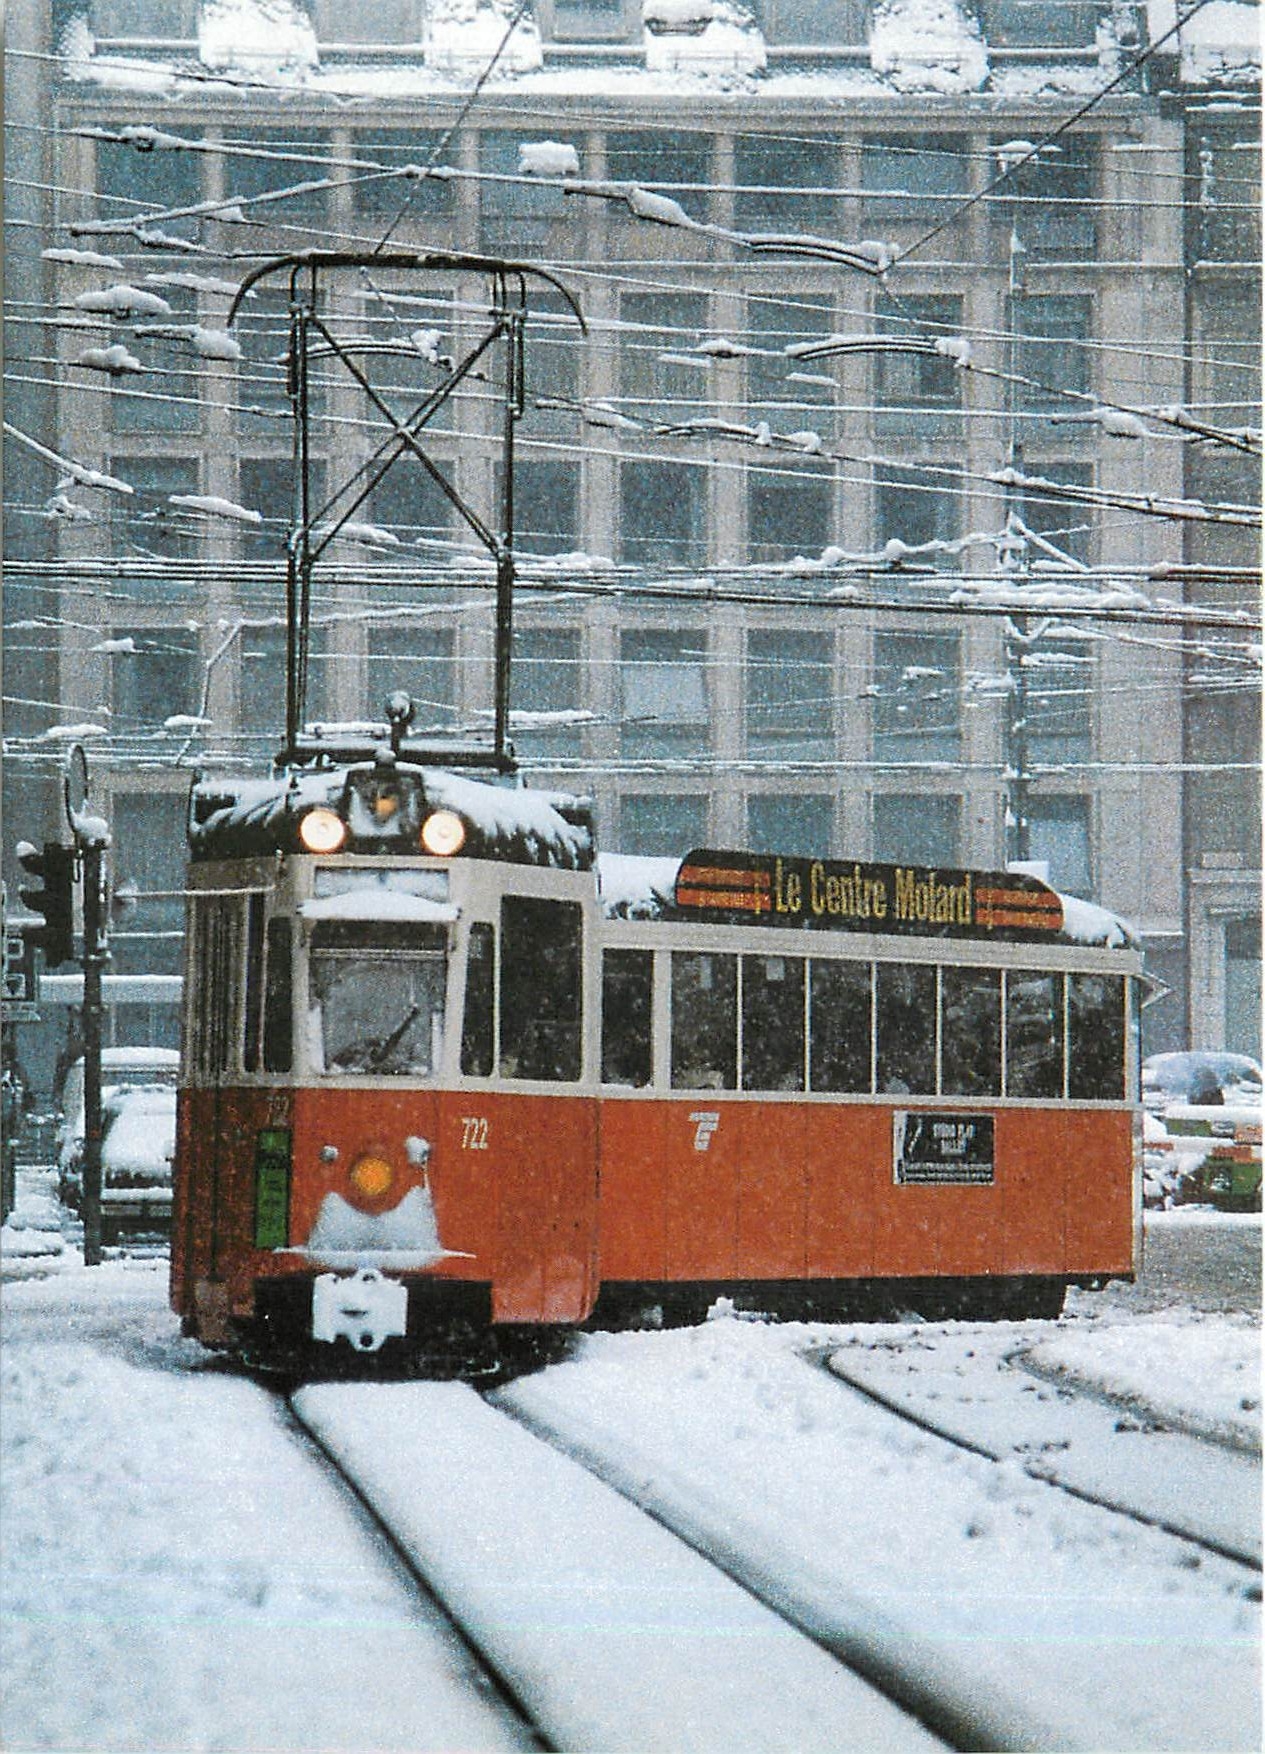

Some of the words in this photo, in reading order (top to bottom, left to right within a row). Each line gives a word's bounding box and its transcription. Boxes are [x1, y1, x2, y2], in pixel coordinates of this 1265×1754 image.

[775, 857, 802, 913] Le
[811, 861, 888, 919] Centre
[895, 867, 972, 925] Molard
[461, 1117, 489, 1150] 722
